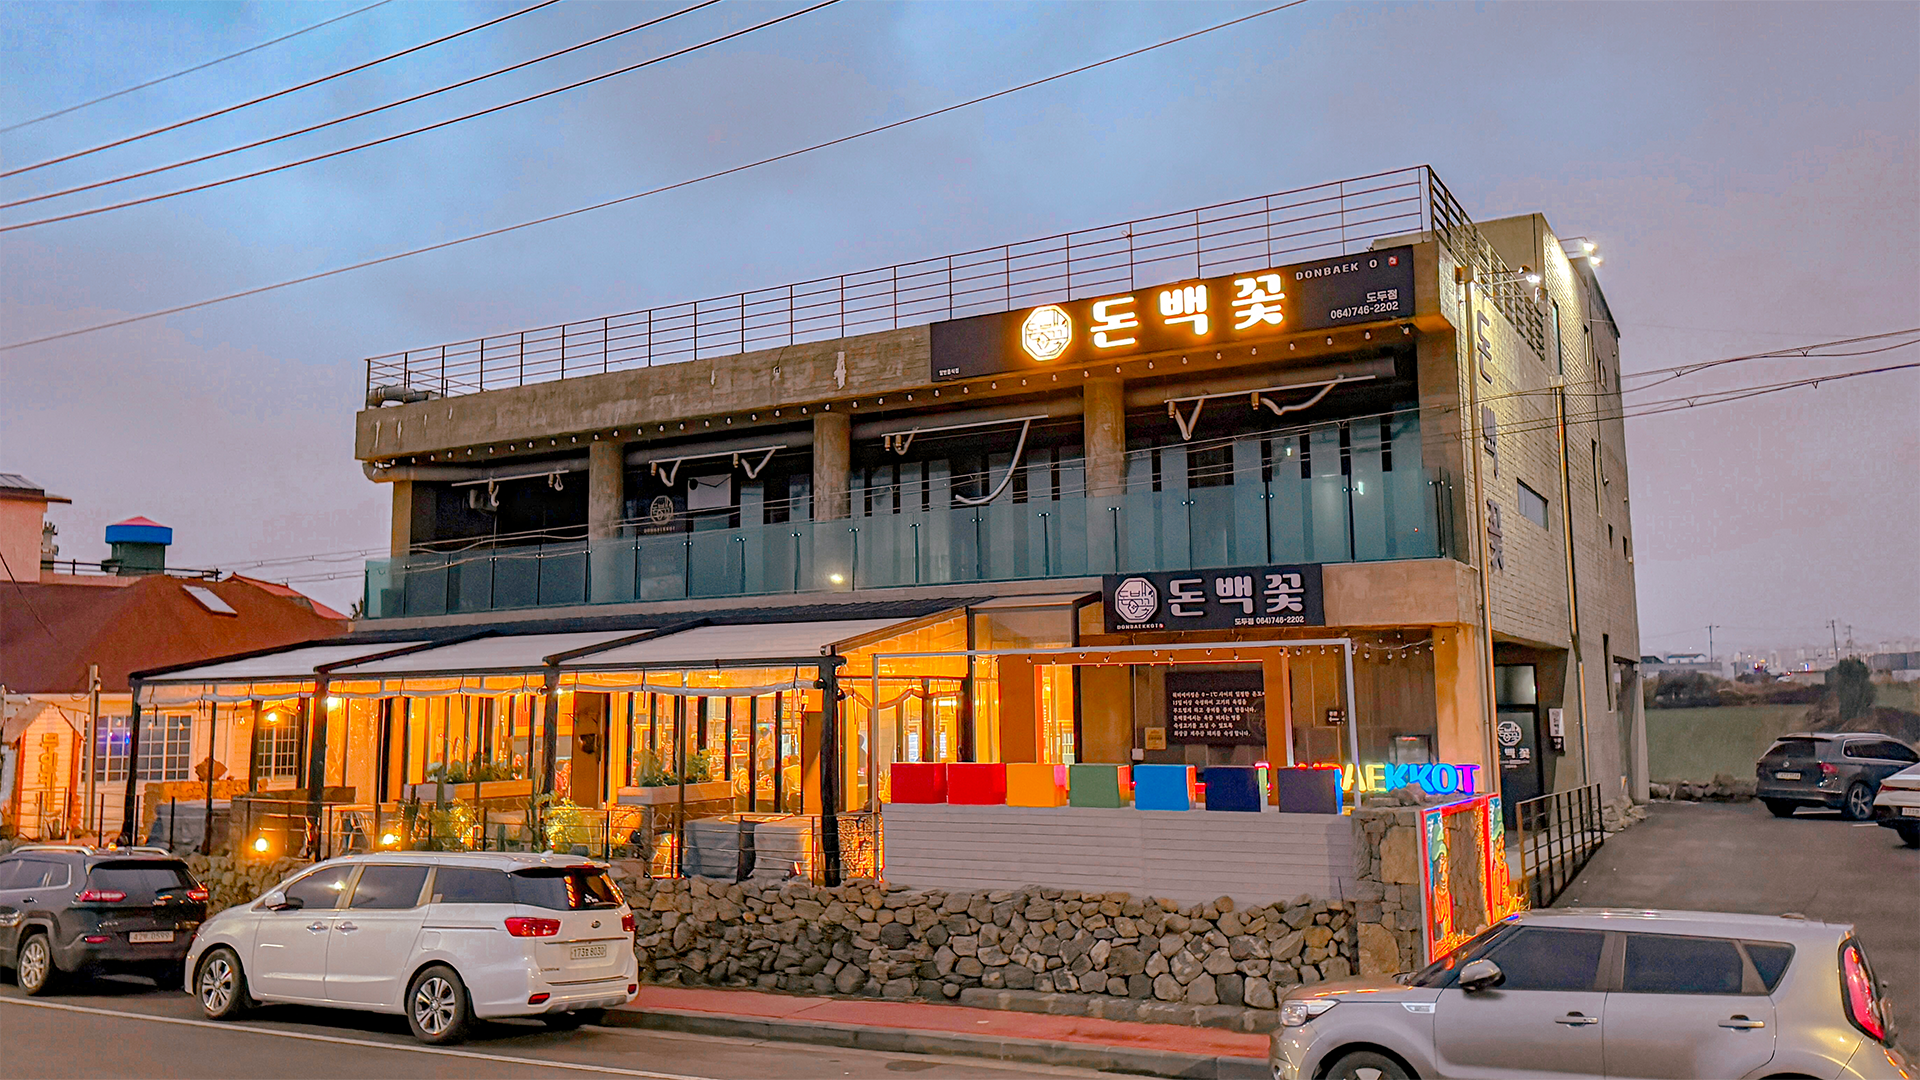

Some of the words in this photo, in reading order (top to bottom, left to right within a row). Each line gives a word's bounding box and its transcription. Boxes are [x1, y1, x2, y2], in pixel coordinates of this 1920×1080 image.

[1295, 262, 1359, 281] DONBAEK
[1366, 288, 1398, 303] 도두점
[1330, 301, 1399, 319] 064)746-2202
